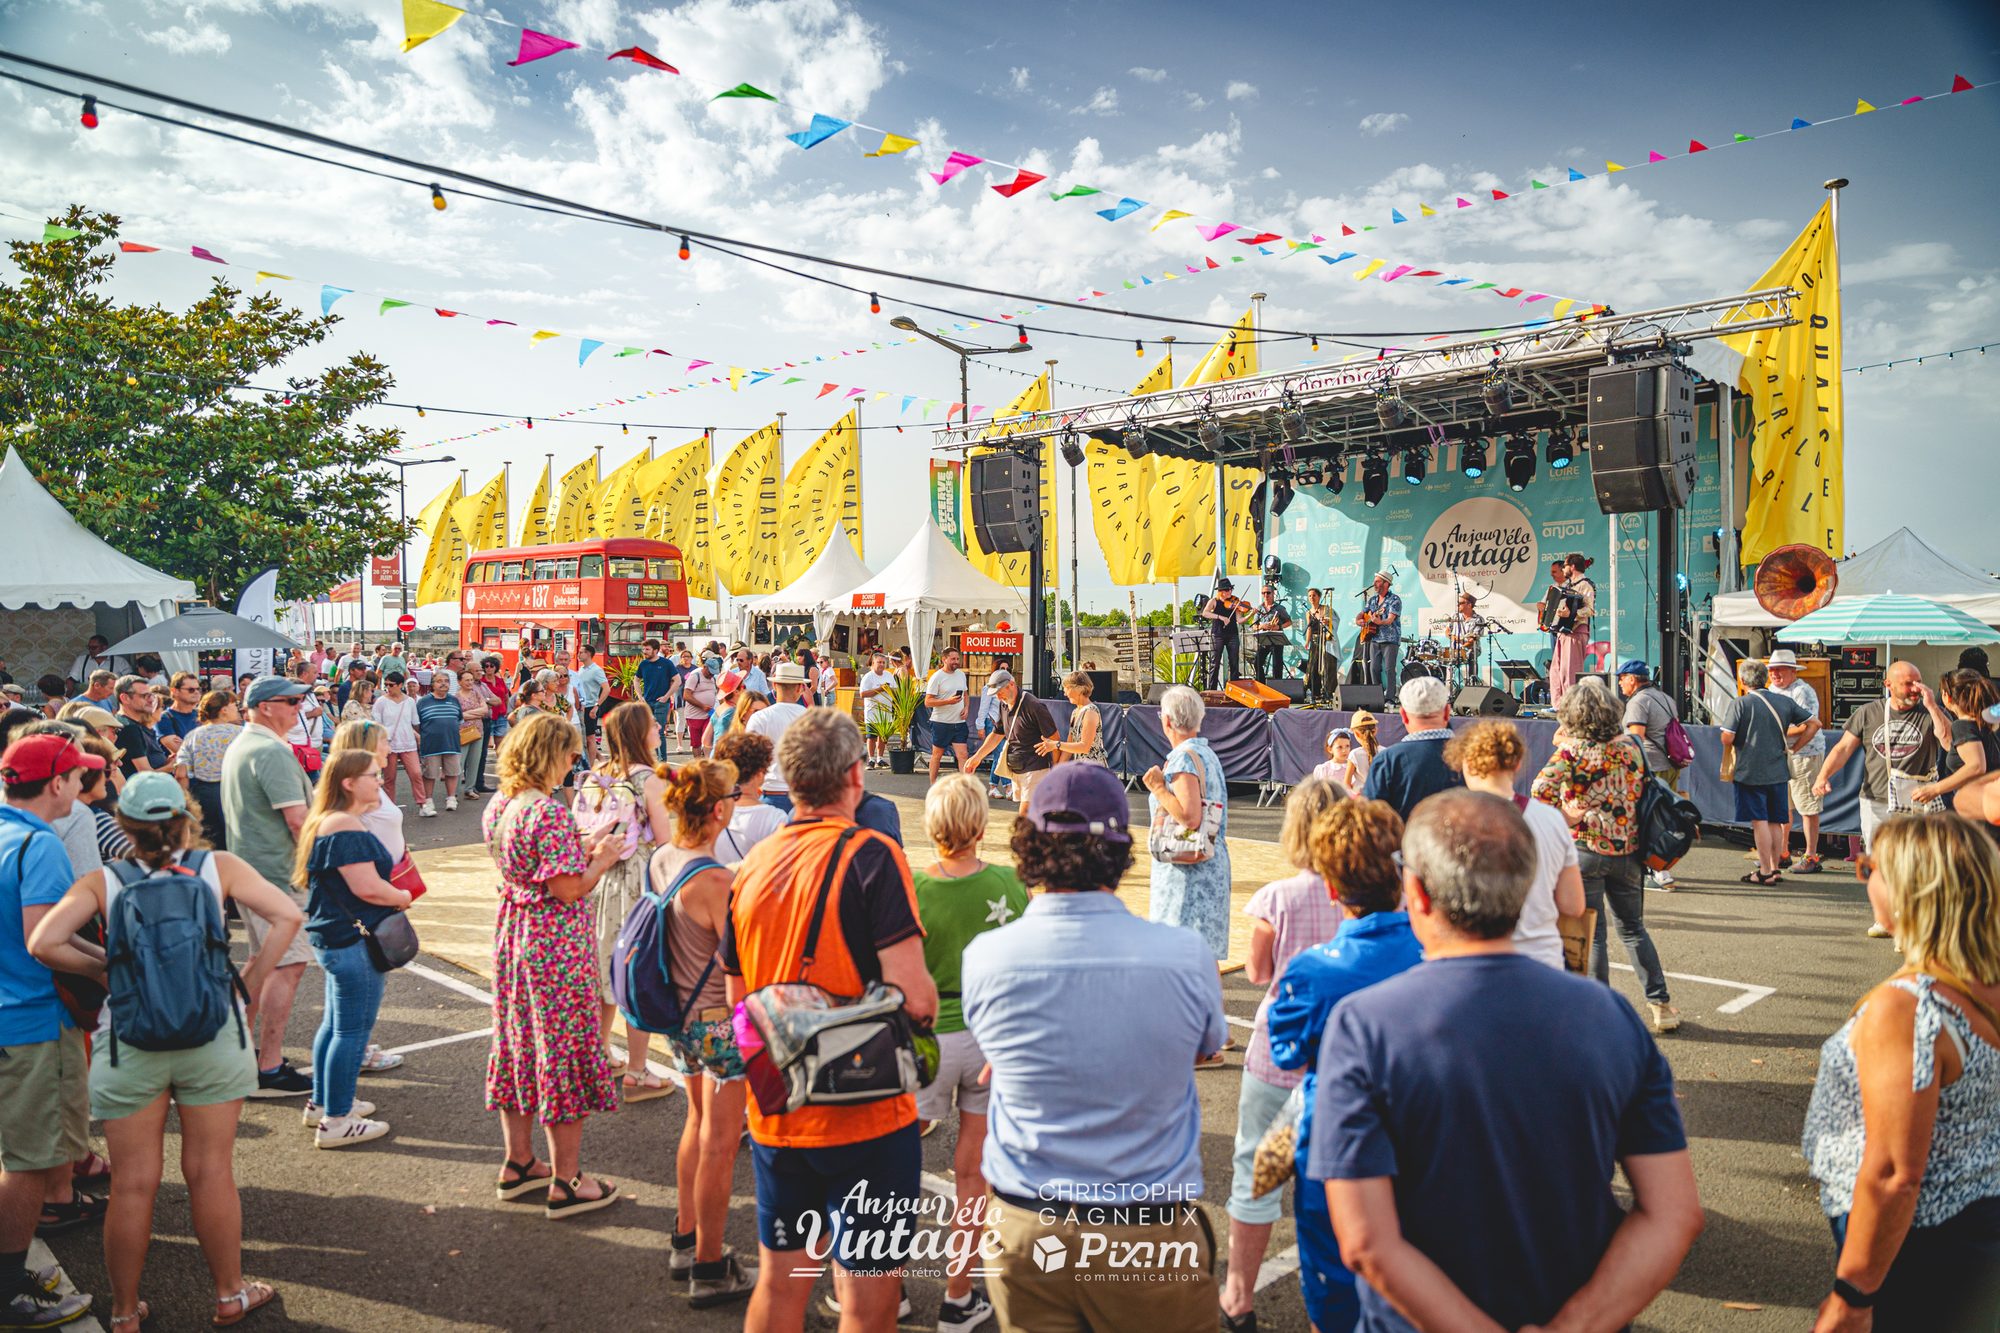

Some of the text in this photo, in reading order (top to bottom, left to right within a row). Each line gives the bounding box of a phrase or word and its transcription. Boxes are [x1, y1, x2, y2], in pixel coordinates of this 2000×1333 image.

[693, 488, 709, 548] QUAIS
[760, 476, 777, 540] QUAIS
[1447, 523, 1532, 547] Anjou Vélo
[1542, 526, 1585, 539] anjou
[1424, 541, 1531, 574] Vintage
[1328, 565, 1353, 575] SNEG
[532, 584, 550, 608] 137
[173, 636, 233, 645] LANGLOIS
[966, 636, 1017, 648] ROUE LIBRE
